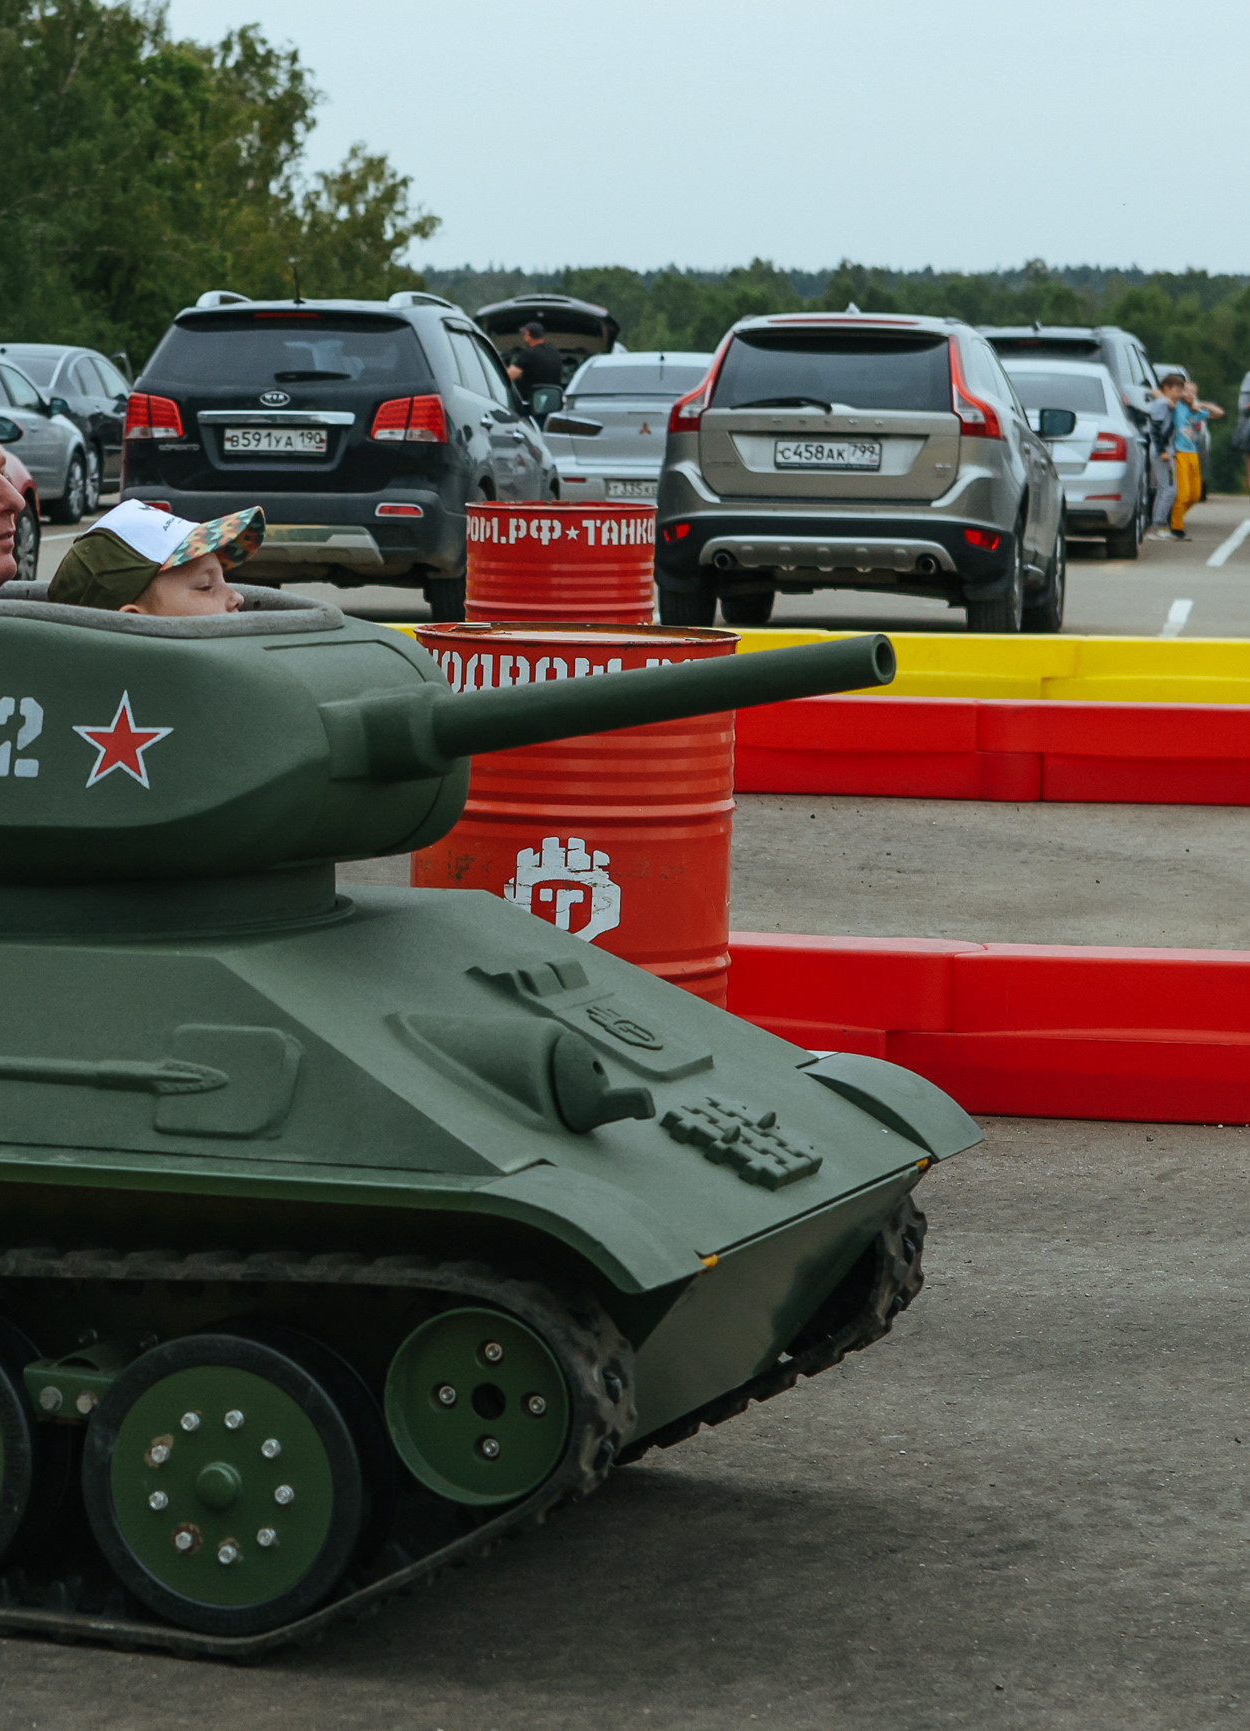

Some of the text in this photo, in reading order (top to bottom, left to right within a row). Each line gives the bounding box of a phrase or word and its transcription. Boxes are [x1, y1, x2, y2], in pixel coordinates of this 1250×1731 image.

[298, 432, 321, 445] 190
[781, 443, 876, 461] С458АК 799
